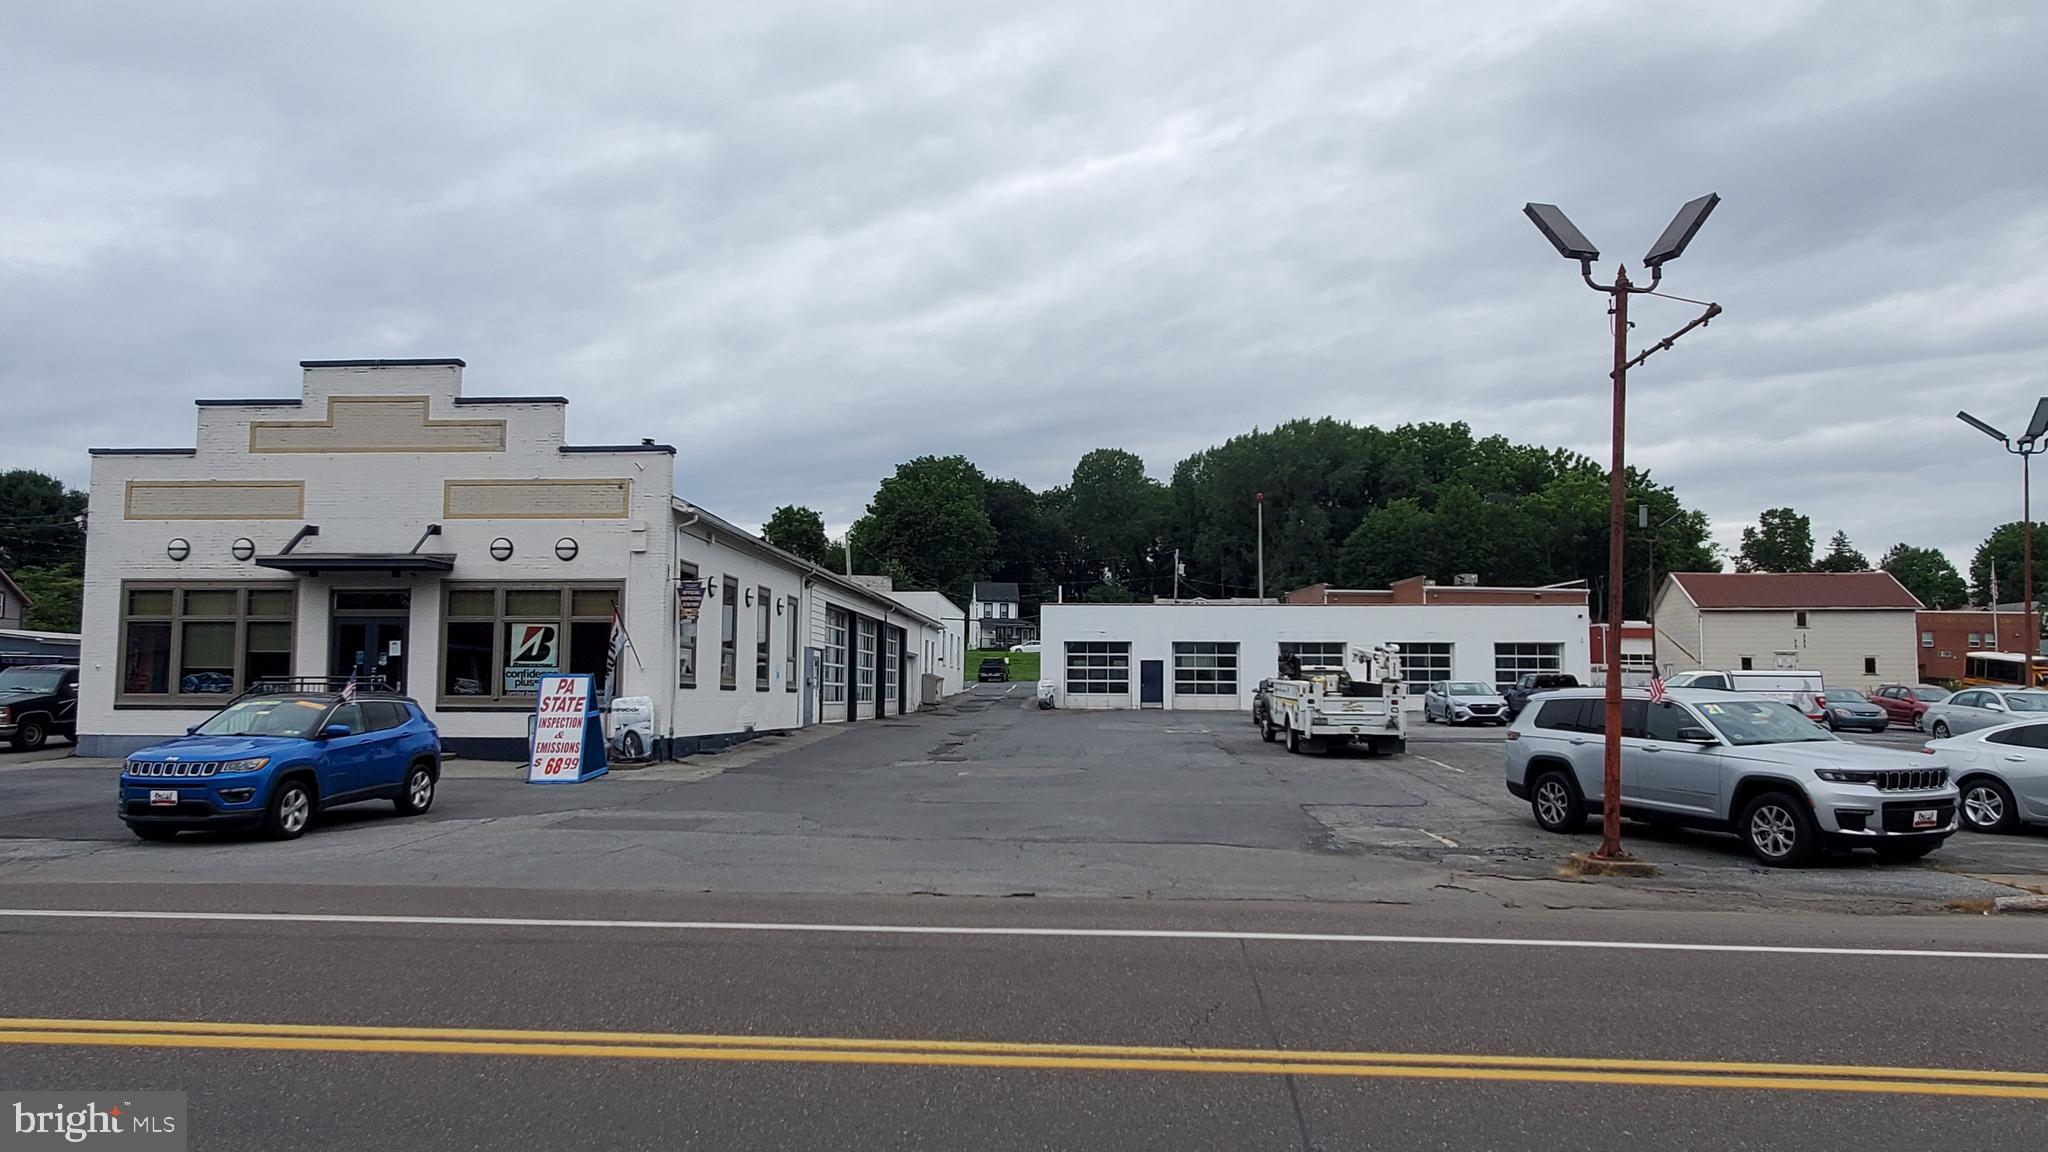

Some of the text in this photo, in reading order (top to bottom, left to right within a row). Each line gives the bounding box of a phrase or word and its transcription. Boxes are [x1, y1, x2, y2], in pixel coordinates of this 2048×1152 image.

[514, 677, 535, 688] plus
[555, 678, 575, 695] PA
[540, 696, 586, 713] STATE
[1703, 703, 1726, 714] 21
[538, 716, 583, 729] INSPECTION
[554, 731, 565, 739] &
[535, 742, 581, 754] EMISSIONS
